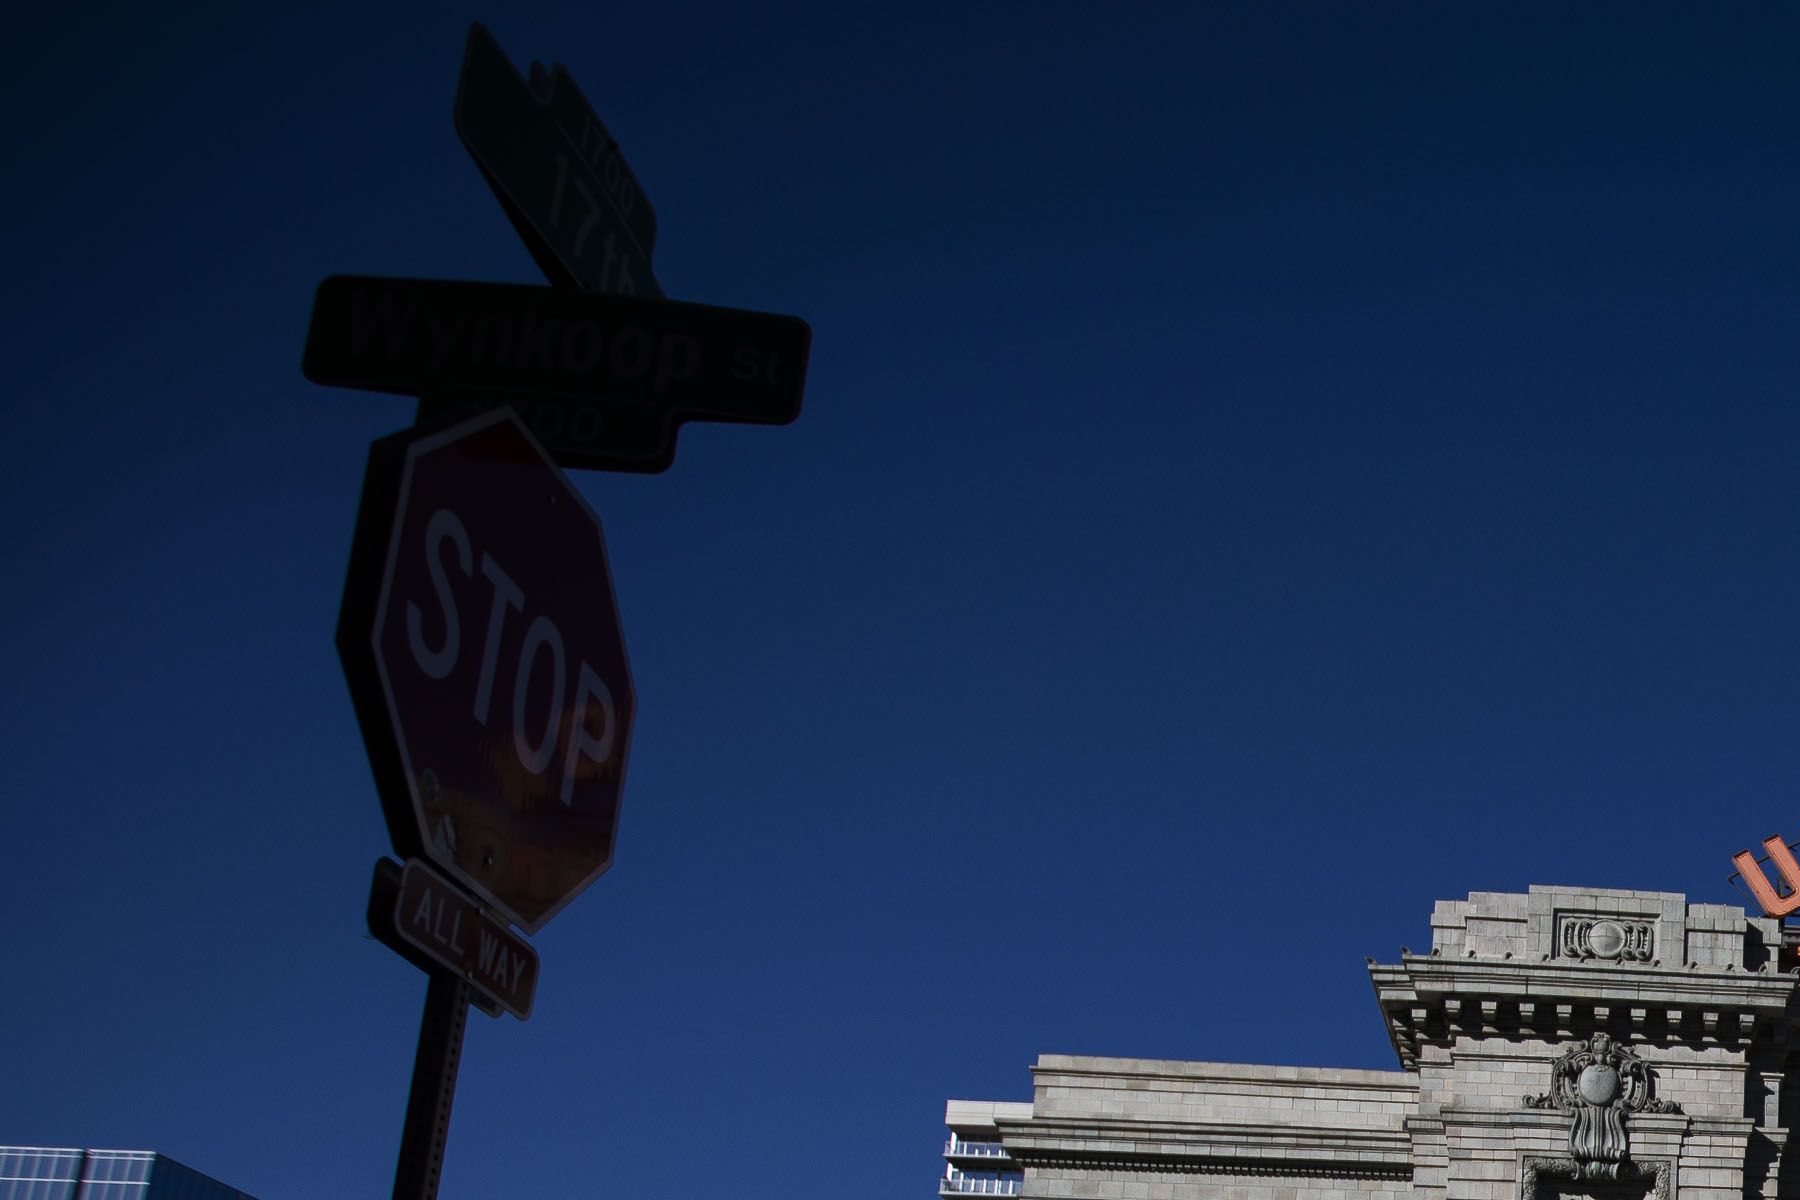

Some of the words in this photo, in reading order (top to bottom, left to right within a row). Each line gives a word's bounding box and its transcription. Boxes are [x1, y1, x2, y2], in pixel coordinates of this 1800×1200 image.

[346, 287, 703, 394] Wynkoop
[729, 343, 784, 386] St
[406, 508, 616, 807] STOP
[413, 888, 464, 958] ALL
[479, 927, 527, 996] WAY
